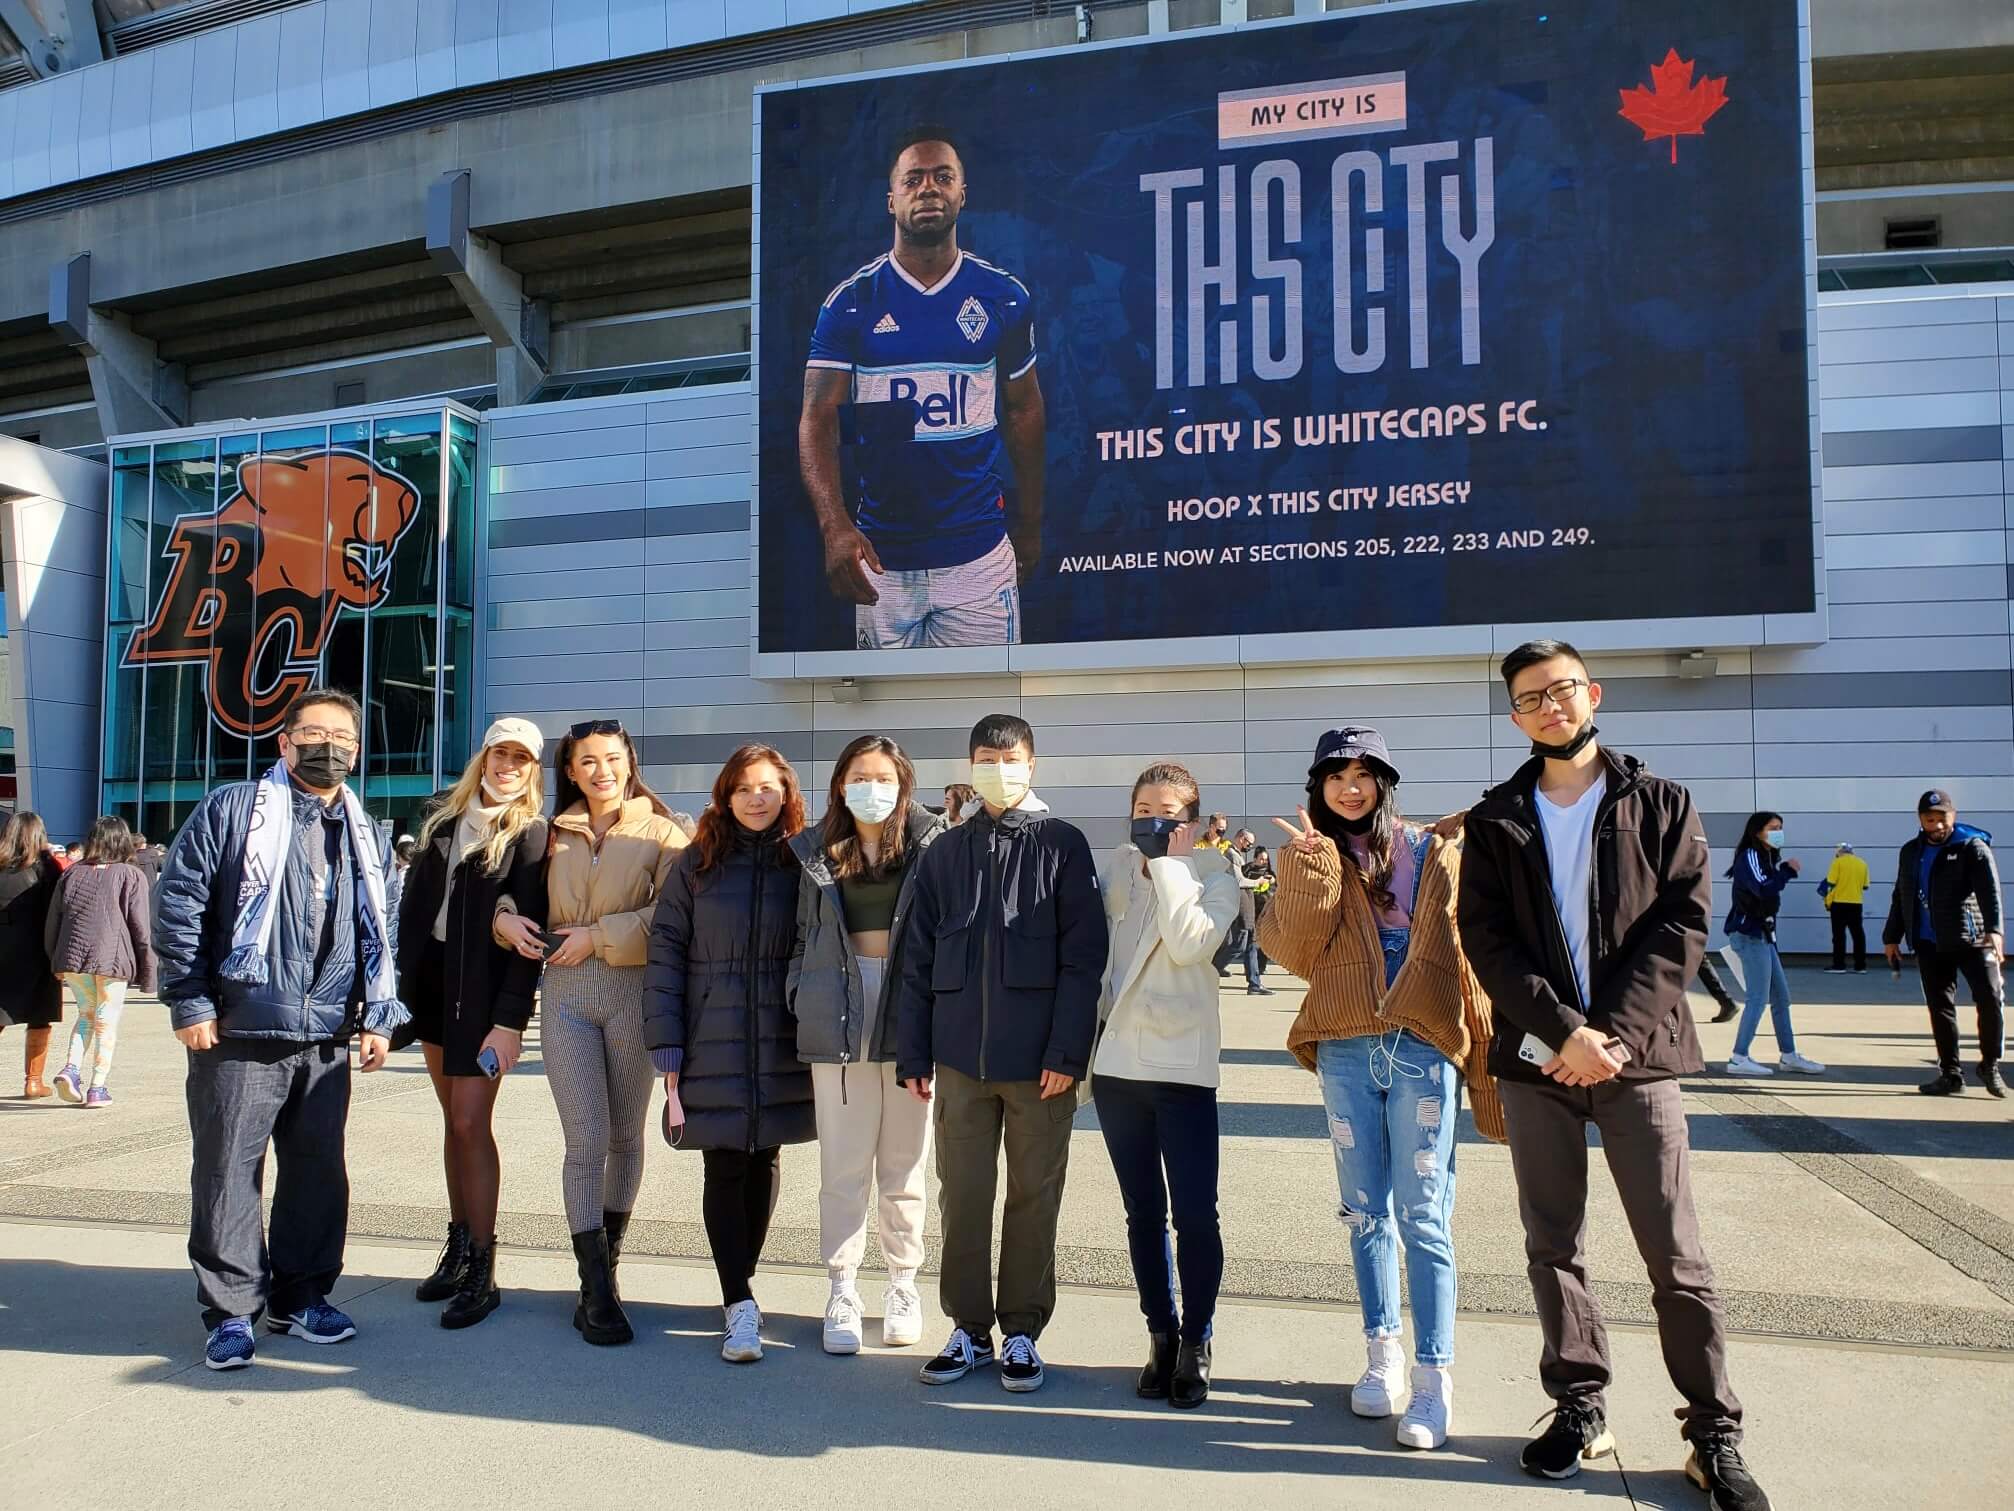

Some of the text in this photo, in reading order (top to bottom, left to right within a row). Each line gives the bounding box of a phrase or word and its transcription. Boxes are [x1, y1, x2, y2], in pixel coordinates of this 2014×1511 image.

[1251, 93, 1377, 127] MY CITY IS
[873, 325, 900, 334] adidas
[1096, 400, 1548, 461] THIS CITY IS WHITECAPS FC.
[1167, 481, 1471, 522] HOOP X THIS CITY JERSEY
[1058, 527, 1595, 573] AVAILABLE NOW AT SECTIONS 205, 222, 233 AND 249.
